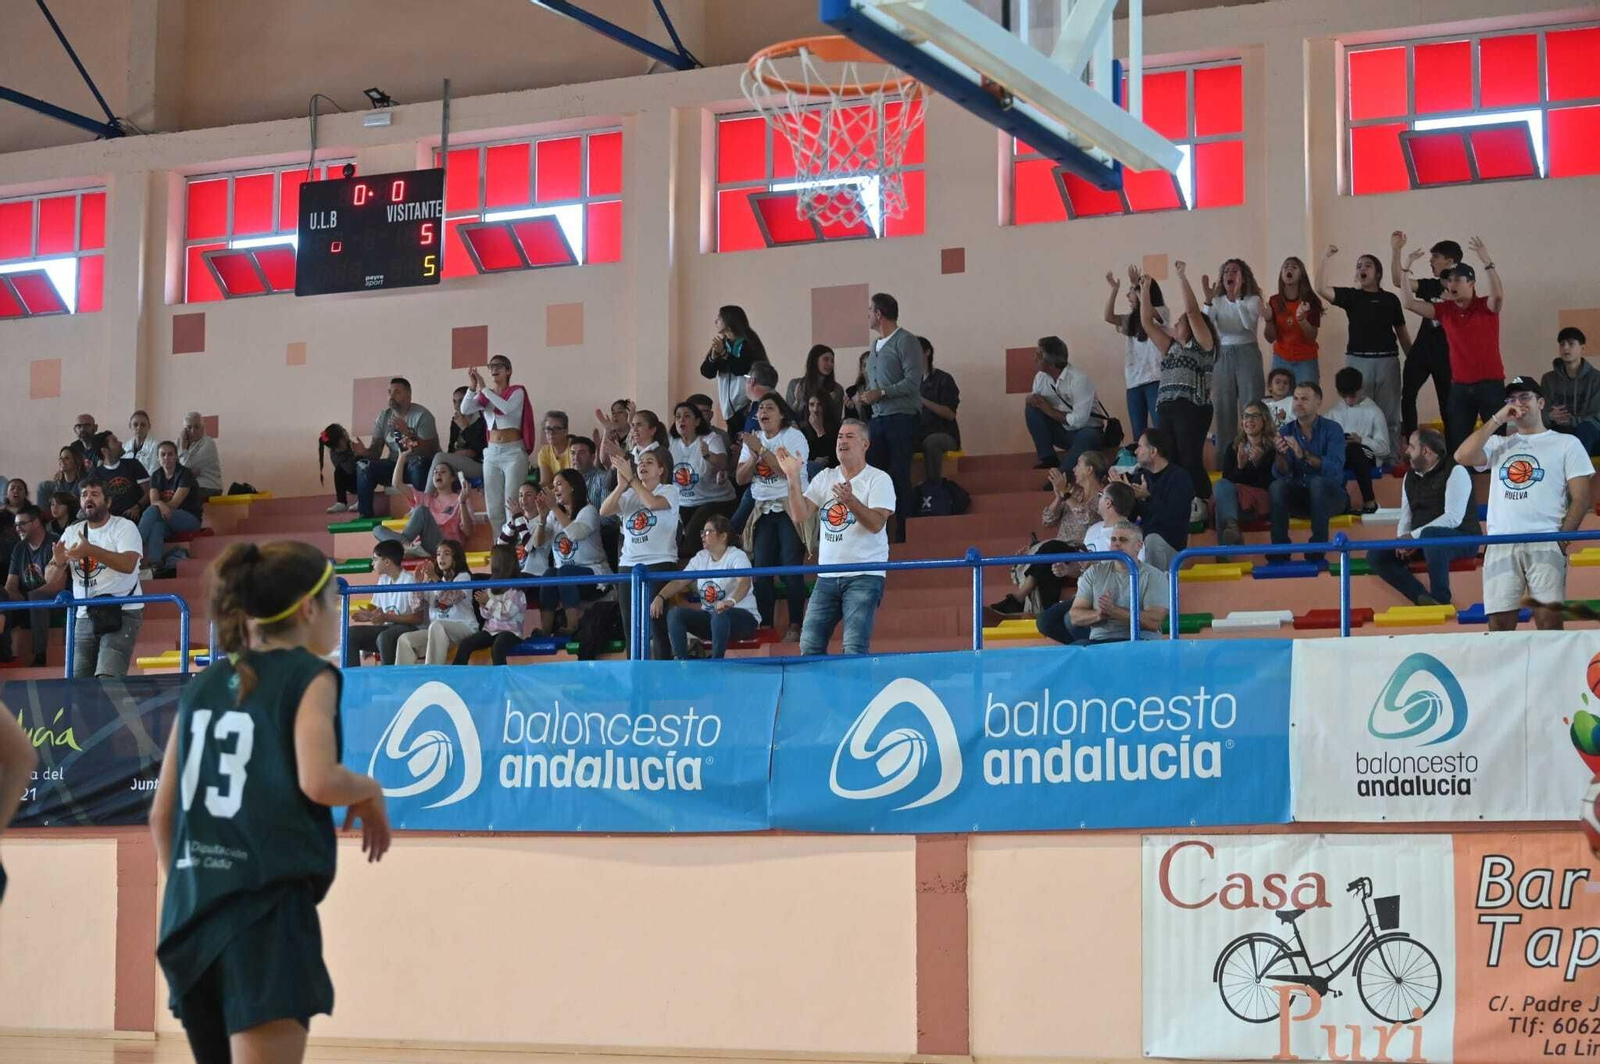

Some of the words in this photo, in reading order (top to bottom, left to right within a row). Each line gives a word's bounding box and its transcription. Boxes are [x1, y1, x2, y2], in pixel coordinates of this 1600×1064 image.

[309, 210, 338, 230] U.L.B
[387, 200, 442, 223] VISITANTE
[420, 223, 433, 245] 5
[423, 255, 435, 276] 5
[1504, 490, 1528, 500] HUELVA
[502, 699, 721, 747] baloncesto
[984, 685, 1237, 738] baloncesto
[181, 708, 255, 818] 13
[499, 749, 702, 791] andalucía
[983, 734, 1222, 786] andalucía
[1356, 751, 1478, 775] baloncesto
[43, 766, 64, 780] del
[1158, 840, 1332, 910] Casa
[1475, 854, 1592, 910] Bar
[1477, 913, 1600, 982] Tap
[1522, 995, 1582, 1012] Padre
[1271, 984, 1427, 1062] Puri
[1508, 1016, 1544, 1038] Tlf:
[1553, 1017, 1600, 1035] 6062
[1543, 1039, 1567, 1056] La
